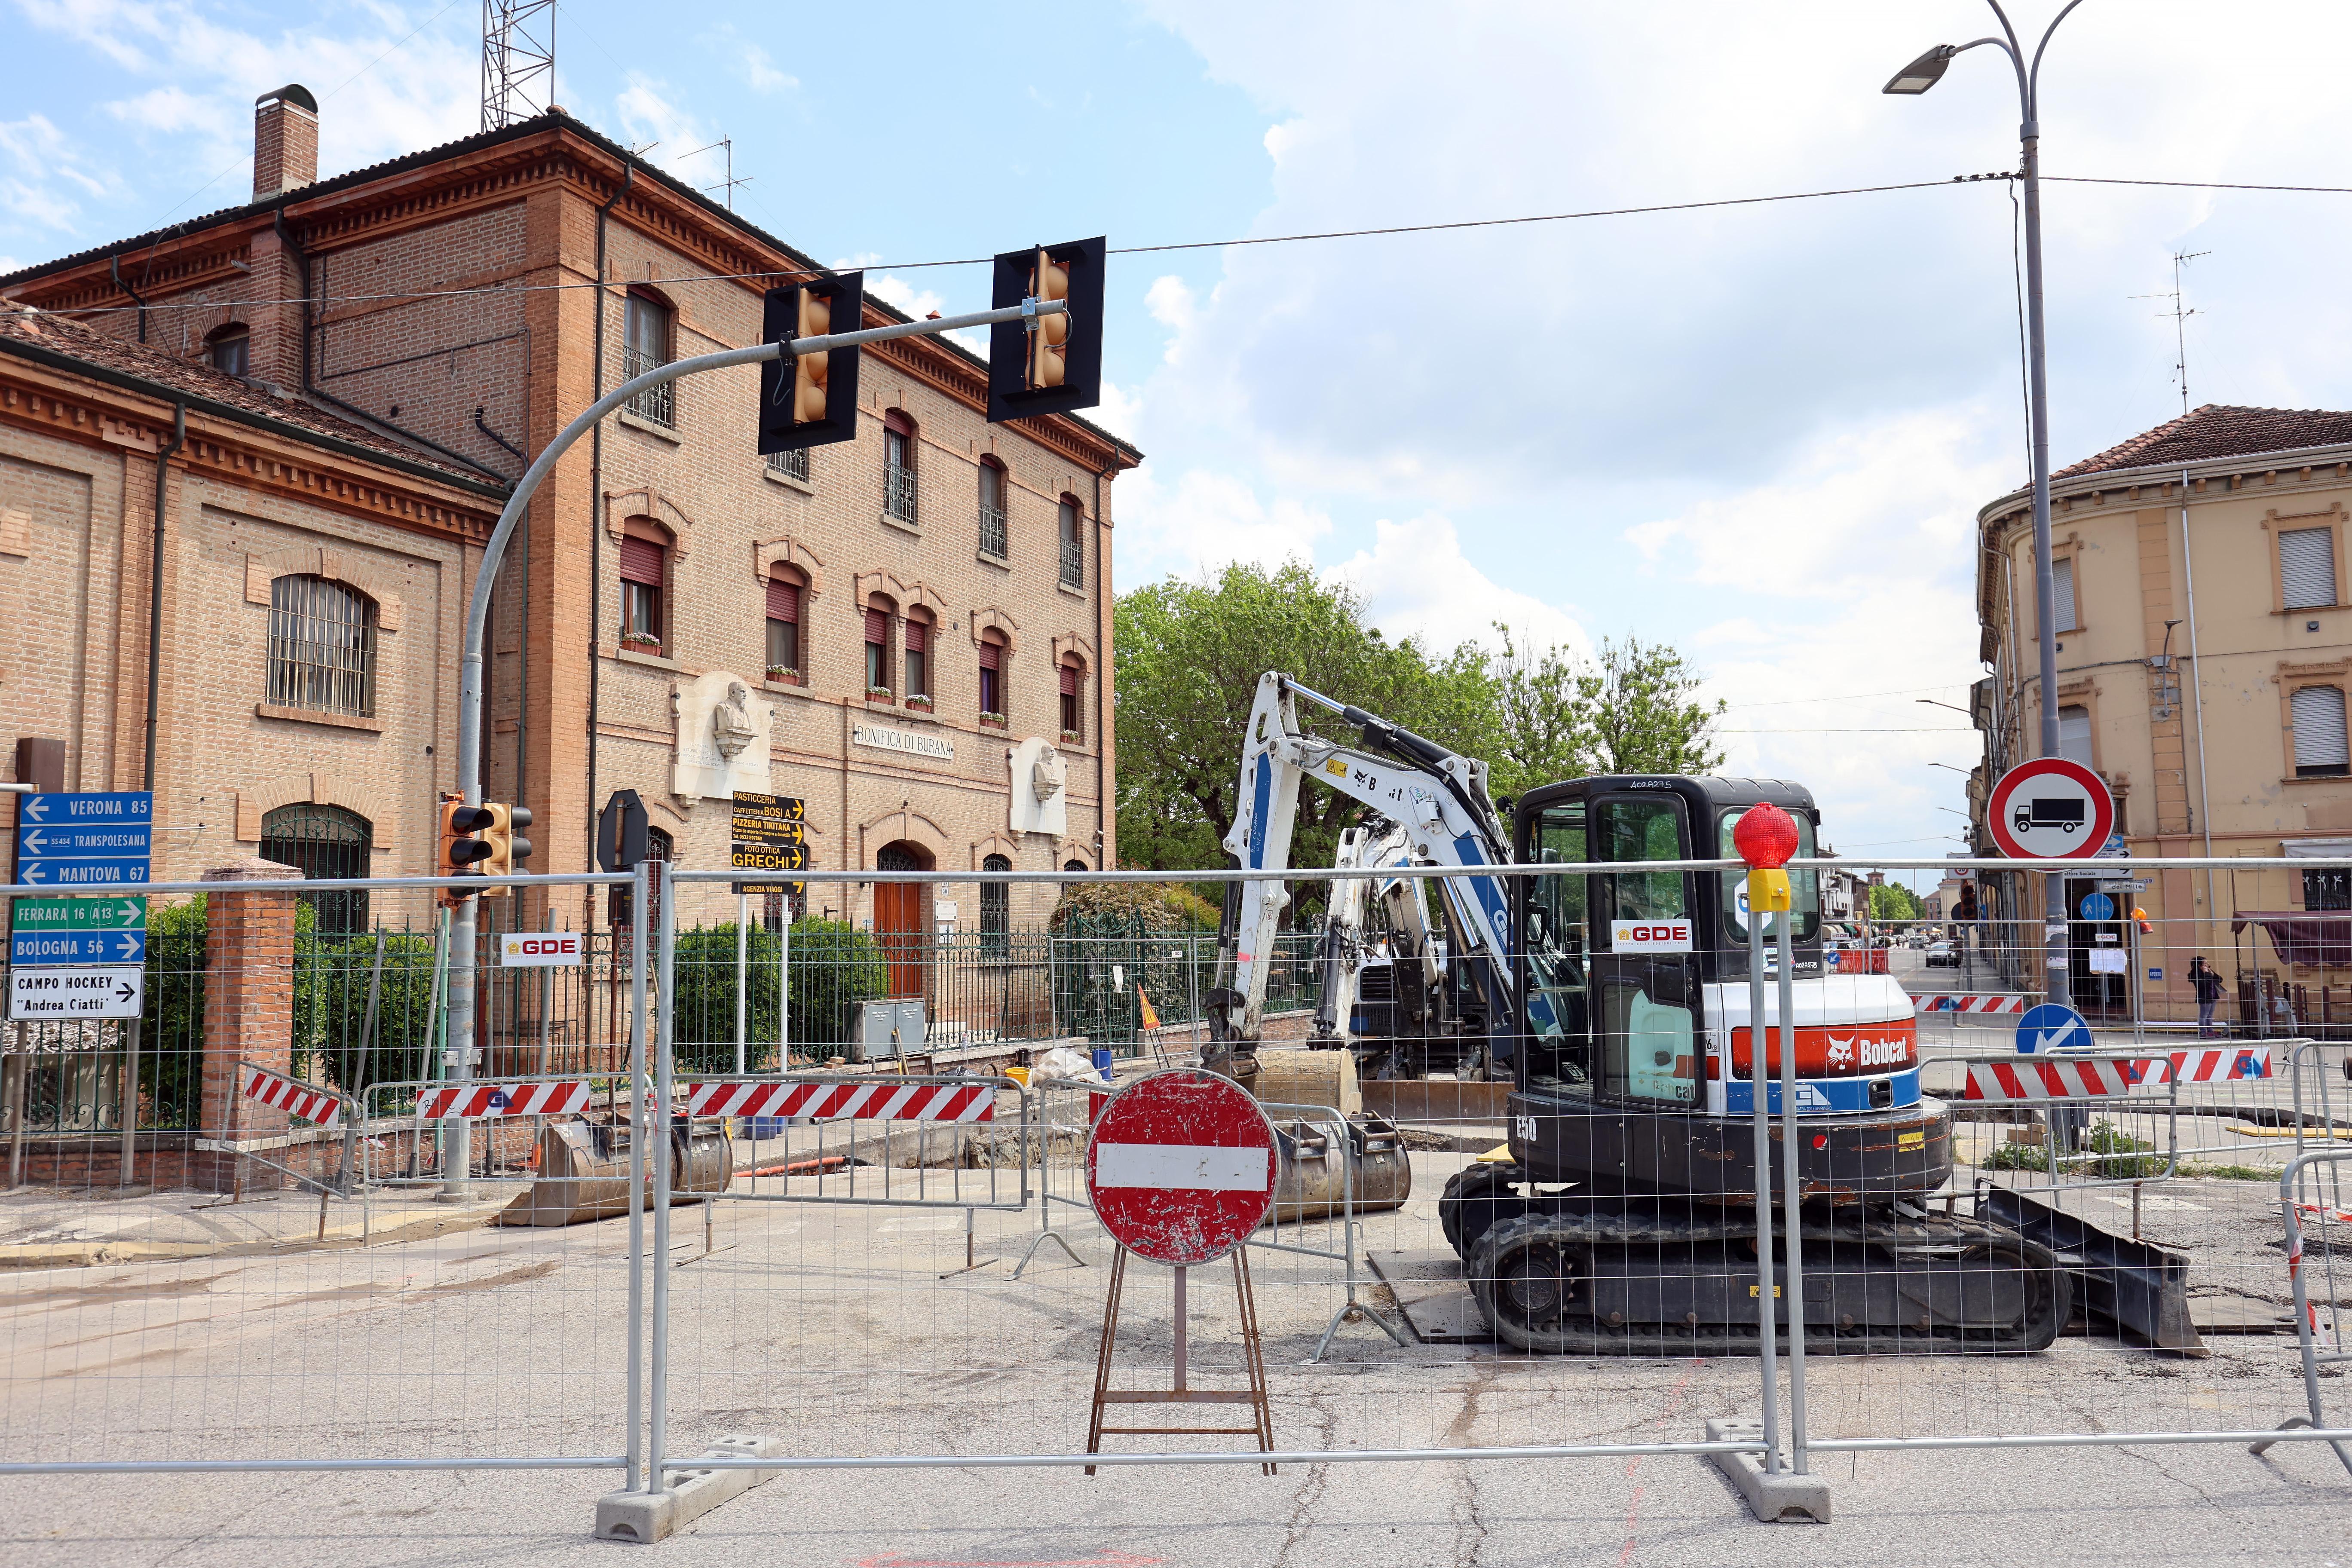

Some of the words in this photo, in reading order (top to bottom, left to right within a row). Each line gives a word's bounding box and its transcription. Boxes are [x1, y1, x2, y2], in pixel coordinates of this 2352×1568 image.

[858, 726, 901, 747] BONIFICA
[905, 735, 913, 749] DI
[918, 737, 951, 756] BURANA
[1630, 781, 1672, 789] A02A275
[734, 792, 776, 805] PASTICCERIA
[70, 800, 122, 815] VERONA
[131, 800, 147, 814] 85
[734, 807, 764, 816] CAFFETTERIA
[764, 806, 783, 818] BOSI
[785, 809, 793, 818] A.
[733, 818, 762, 829] PIZZERIA
[763, 821, 790, 831] TIKITAKA
[75, 835, 145, 847] TRANSPOLESANA
[732, 853, 789, 869] GRECHI
[59, 867, 120, 882] MANTOVA
[129, 867, 144, 880] 67
[18, 908, 67, 921] FERRARA
[74, 908, 85, 920] 16
[1632, 927, 1687, 941] GDE
[17, 941, 78, 956] BOLOGNA
[87, 940, 104, 954] 56
[523, 940, 576, 954] GDE
[18, 978, 58, 989] CAMPO
[65, 977, 113, 989] HOCKEY
[1860, 1036, 1907, 1066] Bobcat
[1516, 1114, 1537, 1142] E50
